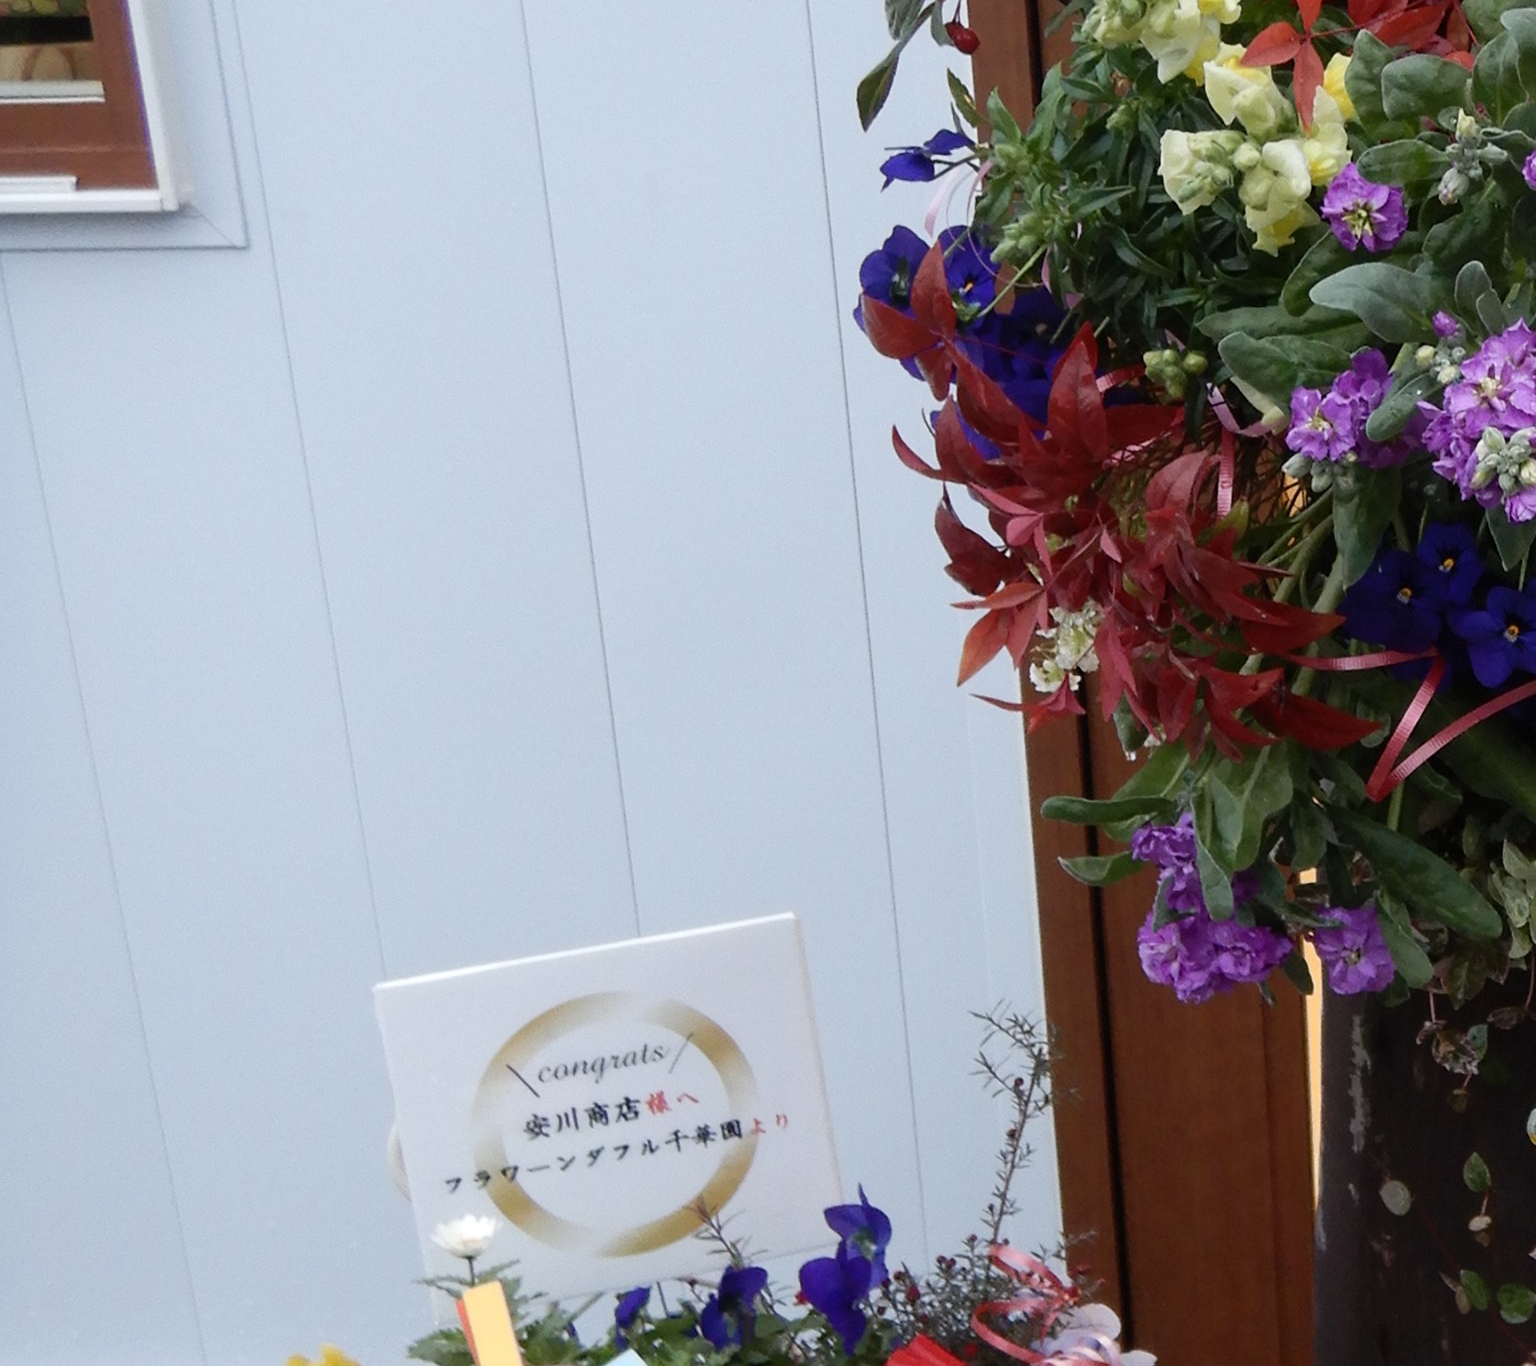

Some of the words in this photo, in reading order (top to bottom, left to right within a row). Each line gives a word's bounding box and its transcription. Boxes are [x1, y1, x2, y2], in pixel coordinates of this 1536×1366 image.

[537, 1043, 668, 1084] congrats
[524, 1090, 699, 1141] 安川商店様へ
